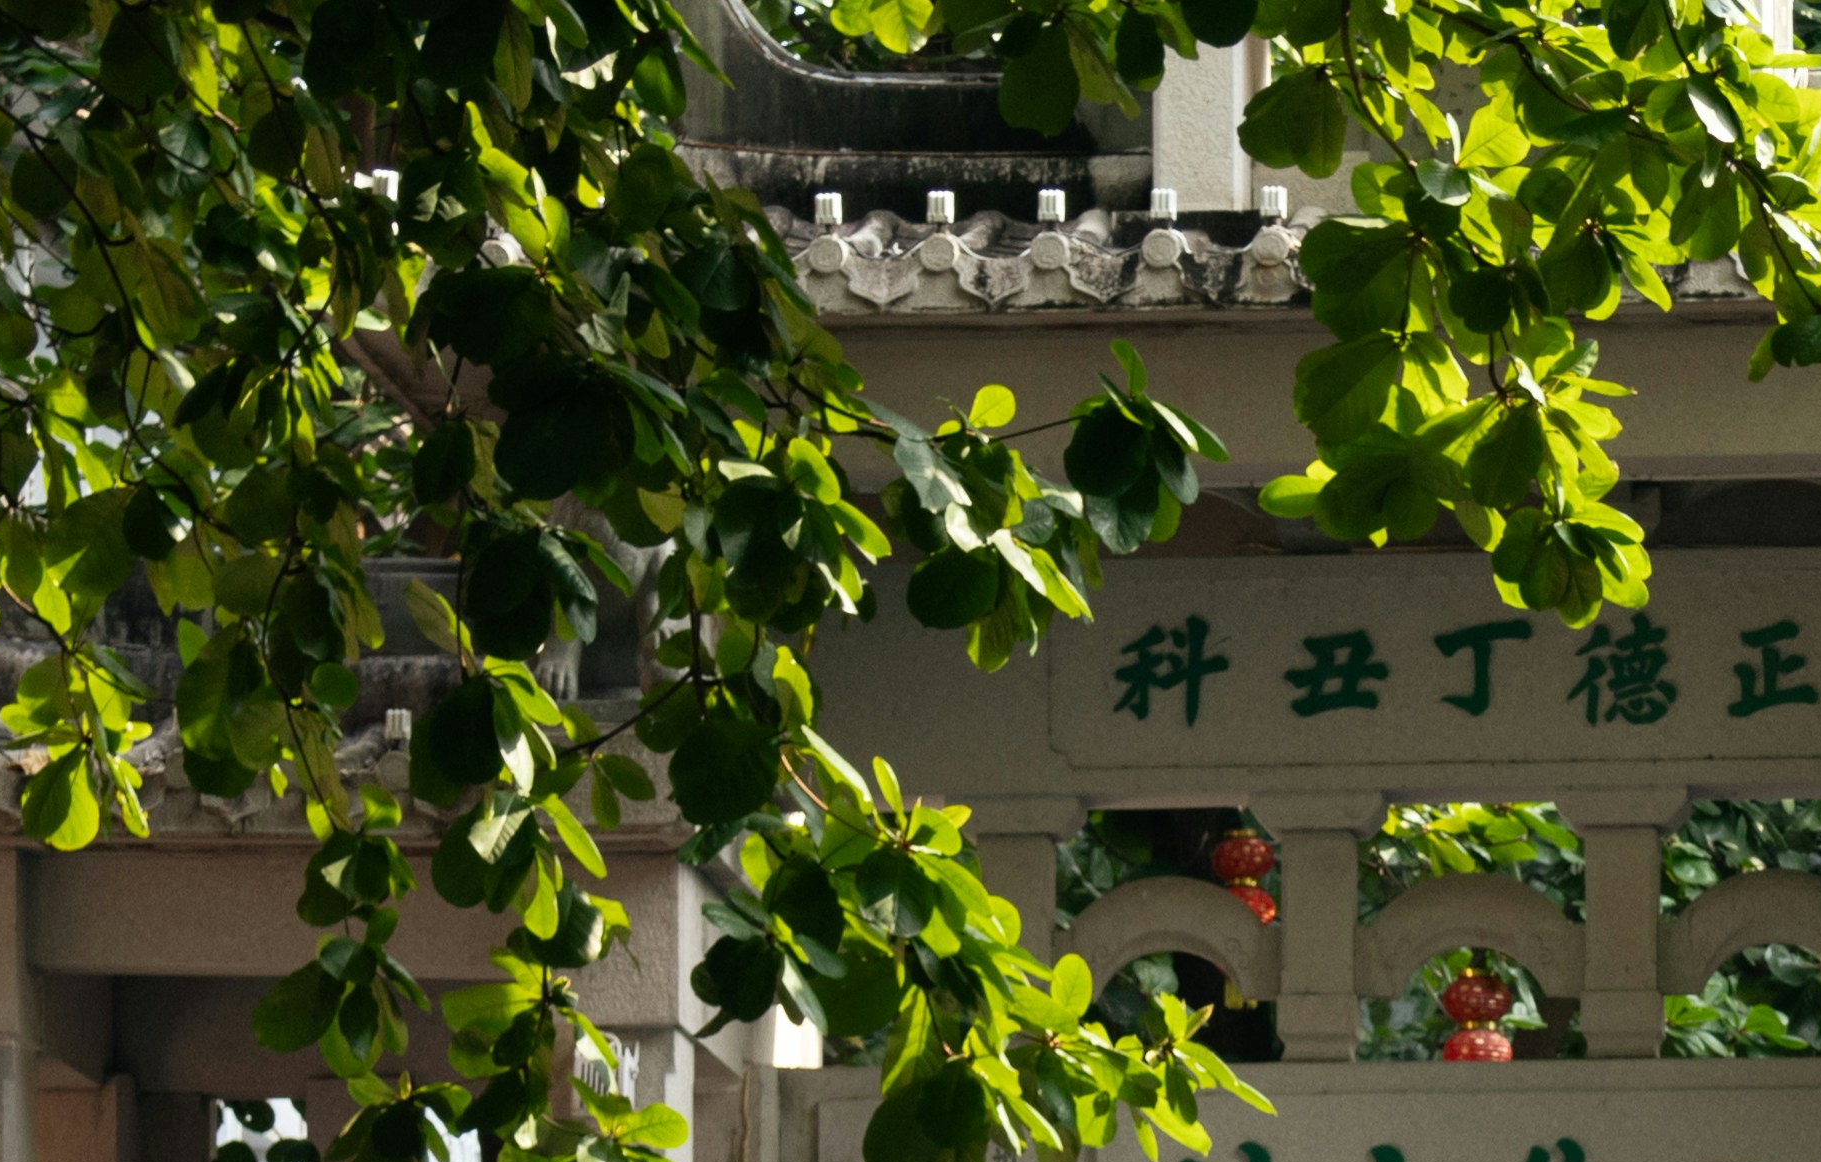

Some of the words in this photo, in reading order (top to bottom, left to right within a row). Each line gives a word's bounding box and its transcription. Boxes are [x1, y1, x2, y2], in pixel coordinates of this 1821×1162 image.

[1113, 612, 1820, 728] 正德丁丑科
